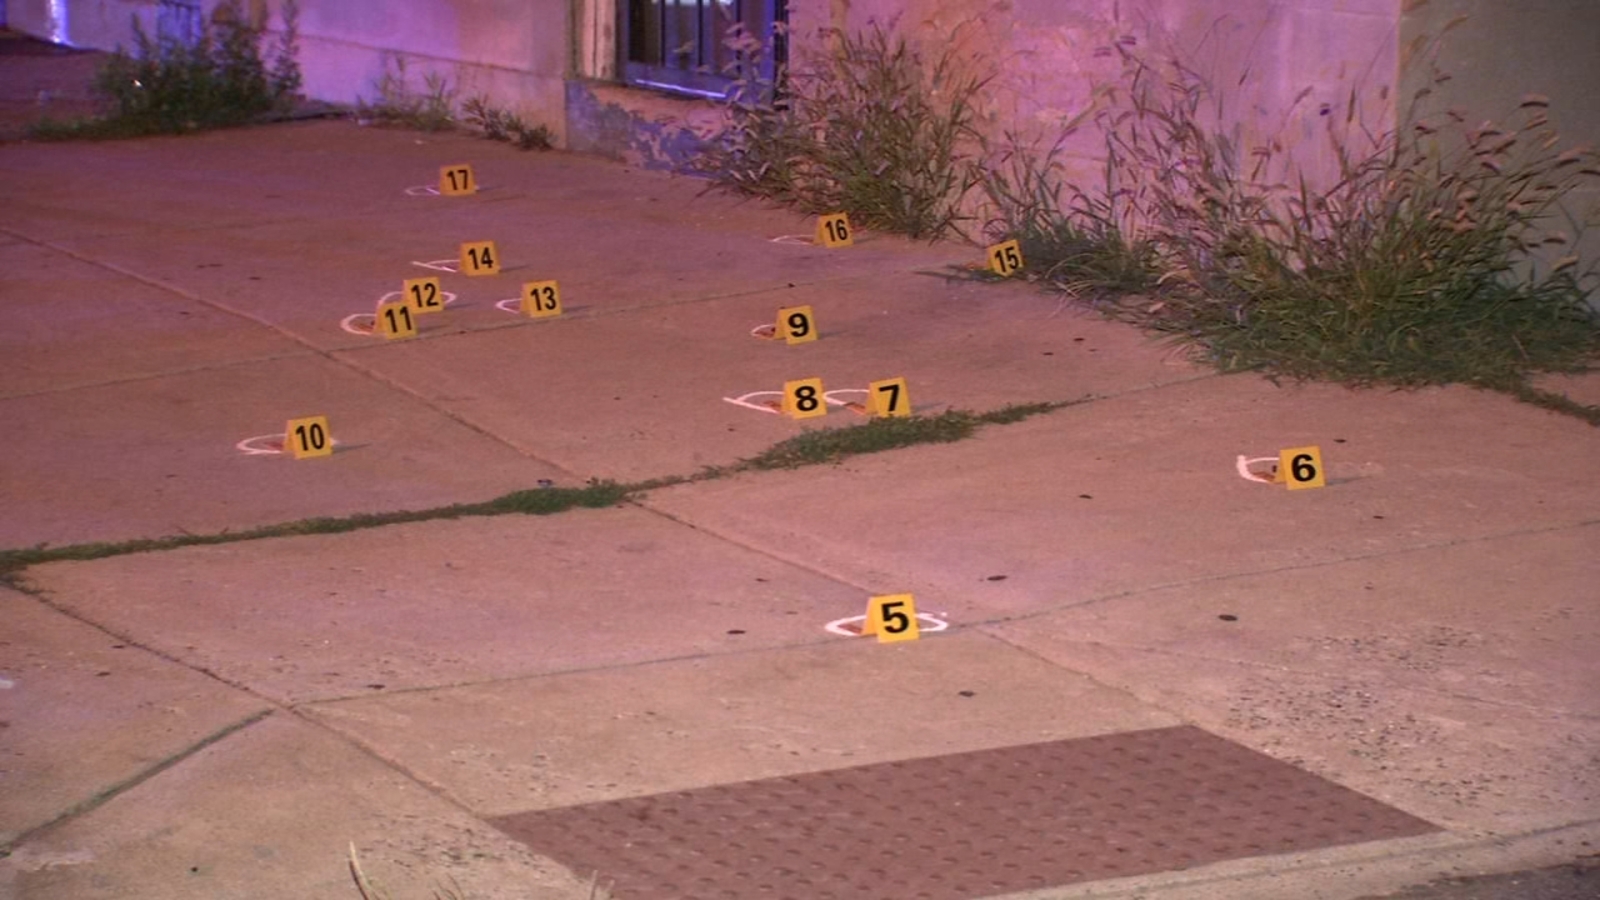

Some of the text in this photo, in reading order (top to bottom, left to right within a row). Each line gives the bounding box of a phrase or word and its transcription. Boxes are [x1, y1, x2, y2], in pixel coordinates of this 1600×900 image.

[447, 169, 468, 191] 17
[825, 218, 848, 242] 16
[468, 247, 494, 270] 14
[995, 246, 1019, 272] 15
[411, 282, 439, 308] 12
[530, 286, 557, 311] 13
[385, 306, 411, 333] 11
[788, 312, 810, 338] 9
[795, 385, 818, 412] 8
[879, 384, 900, 413] 7
[295, 423, 325, 451] 10
[1291, 454, 1316, 482] 6
[882, 601, 909, 634] 5
